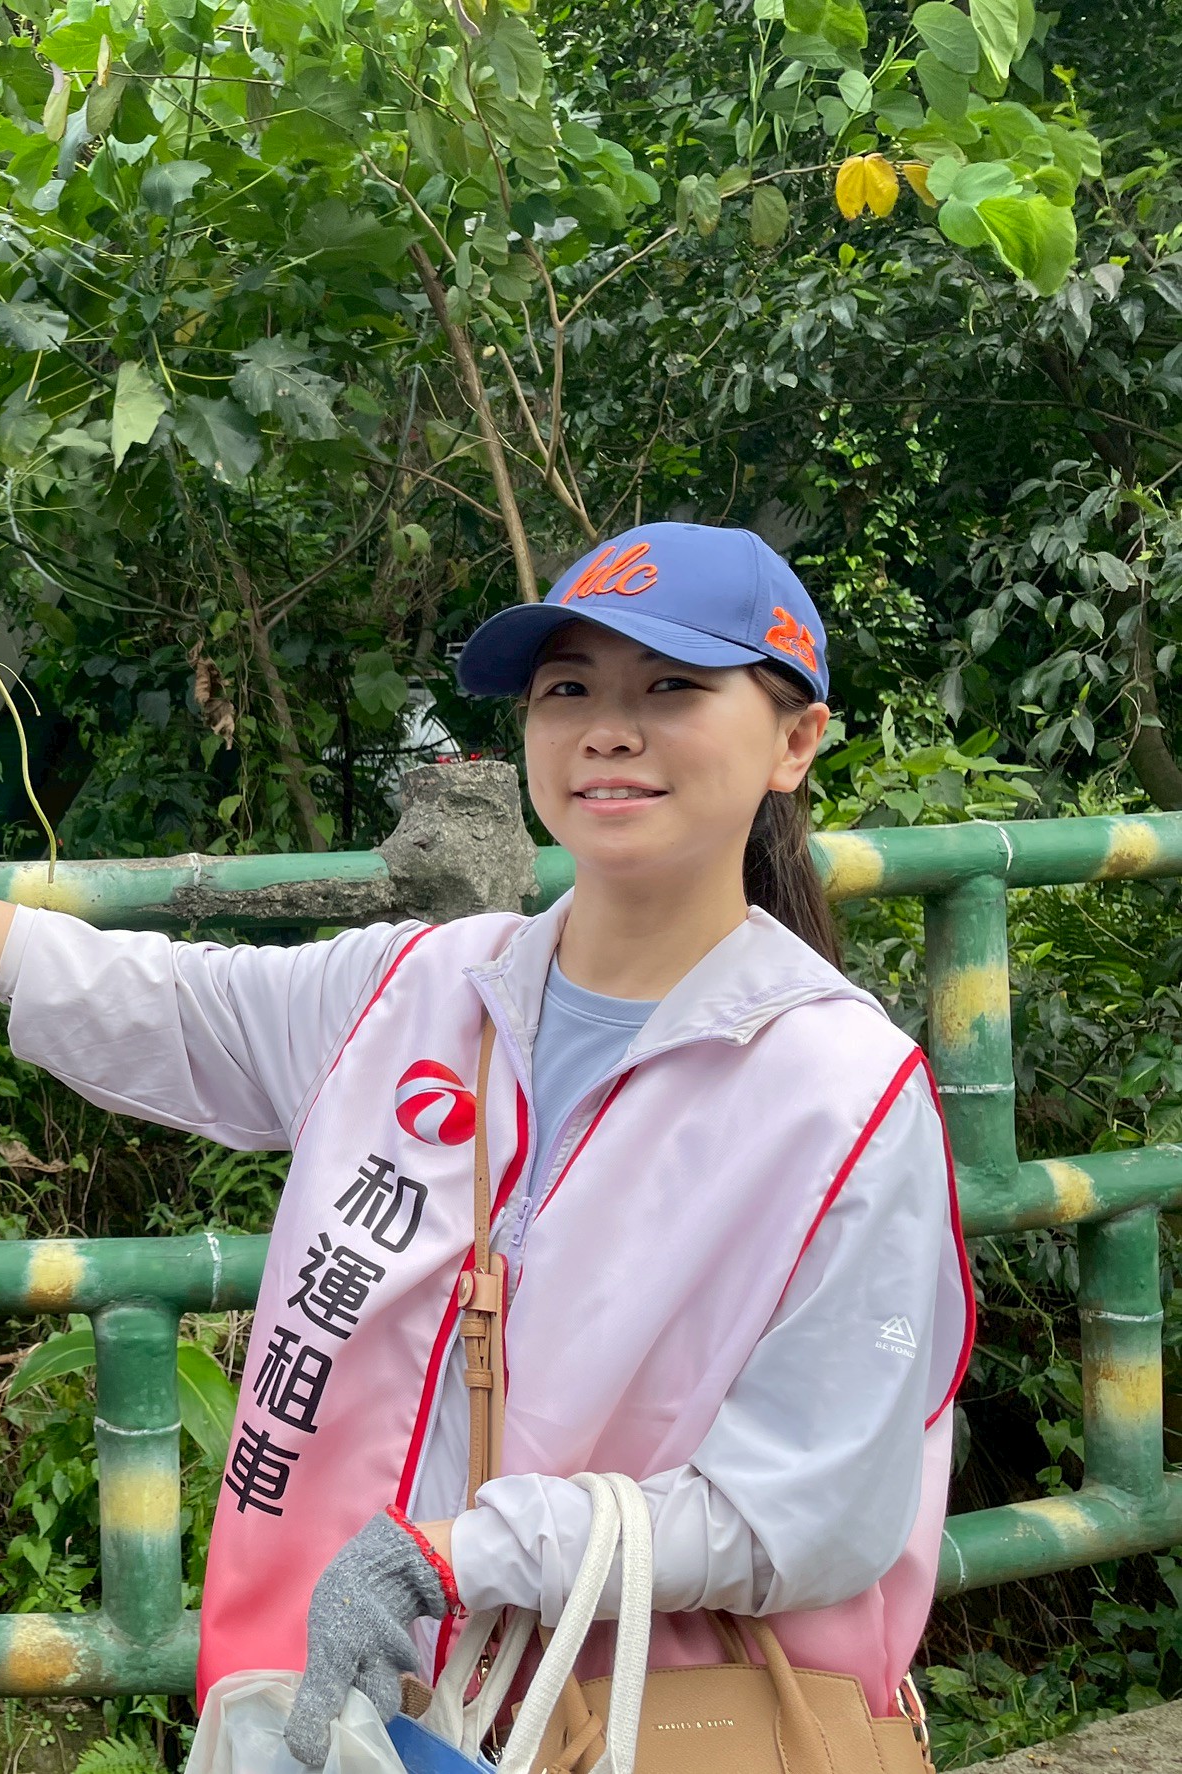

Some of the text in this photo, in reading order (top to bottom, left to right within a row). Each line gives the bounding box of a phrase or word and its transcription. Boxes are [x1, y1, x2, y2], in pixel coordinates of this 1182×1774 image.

[225, 1152, 429, 1517] 和運租車
[875, 1340, 916, 1359] BEYOND
